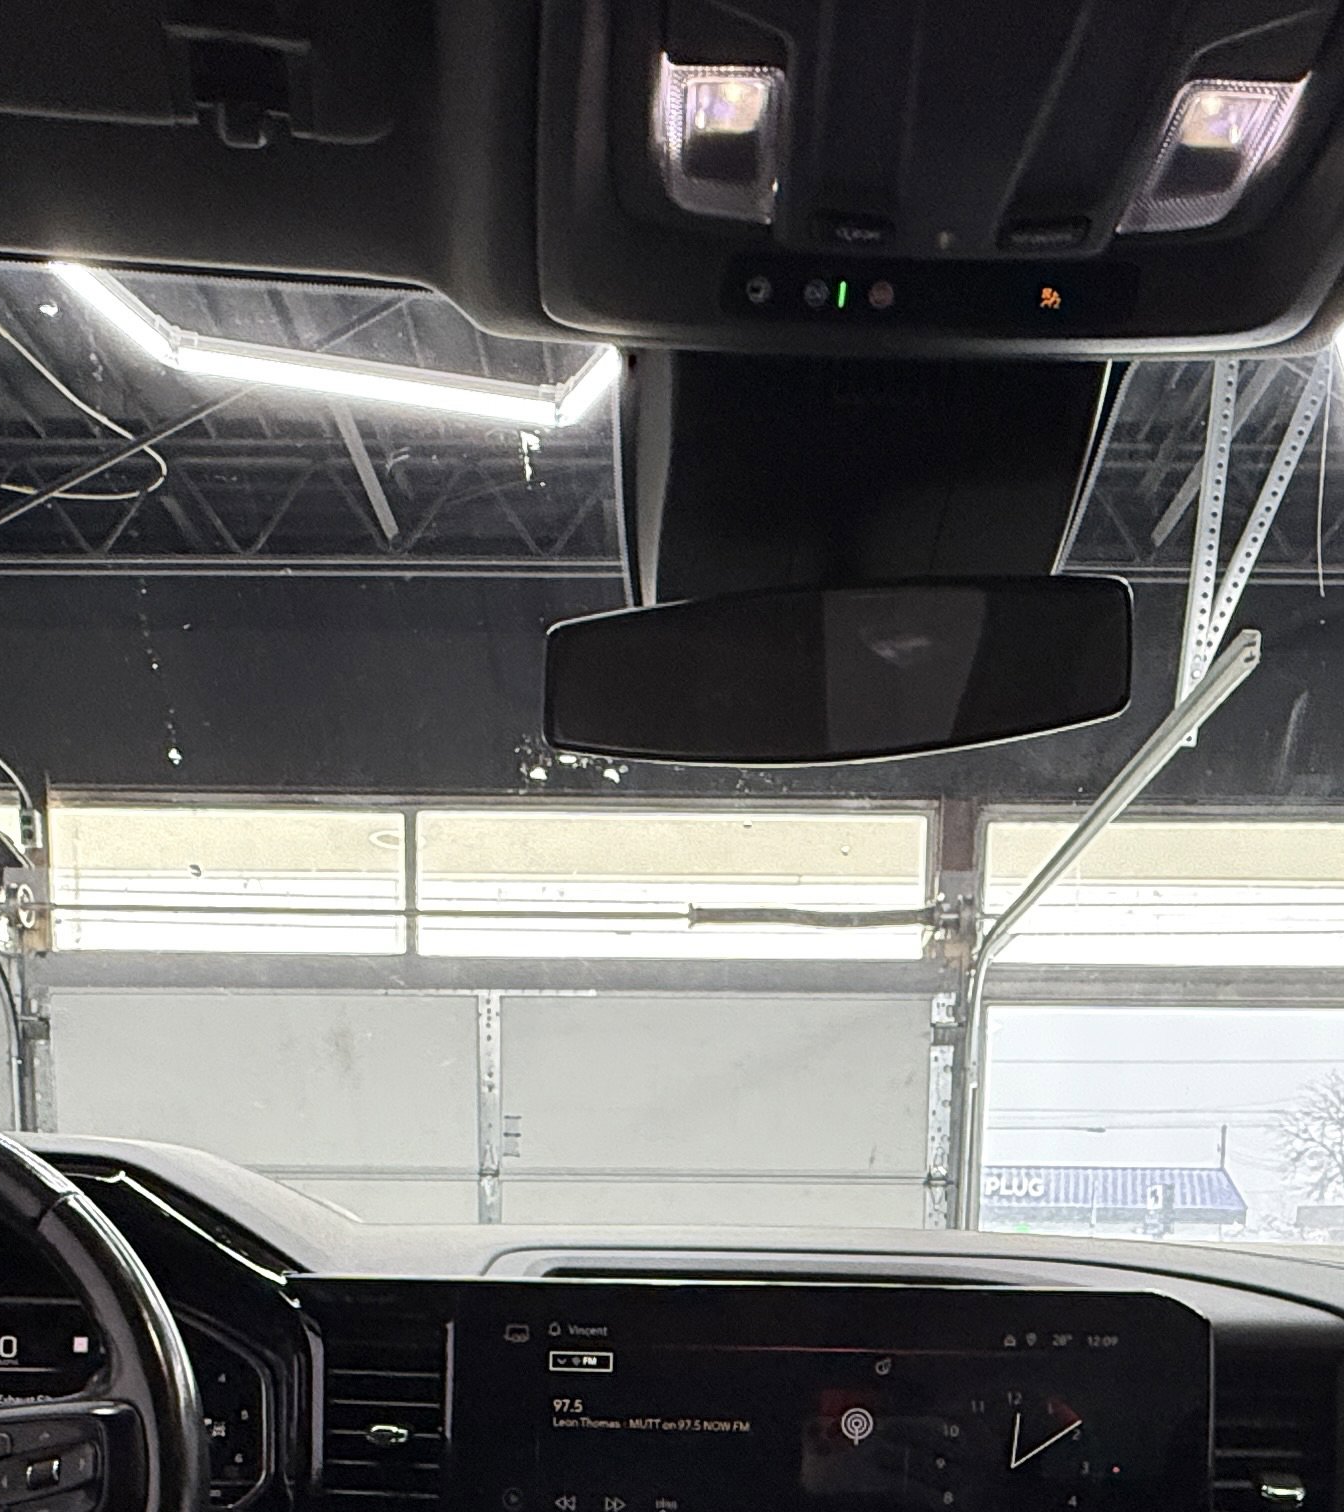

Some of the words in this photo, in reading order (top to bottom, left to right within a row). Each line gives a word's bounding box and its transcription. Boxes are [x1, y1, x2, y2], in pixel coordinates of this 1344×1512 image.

[984, 1175, 1045, 1197] PLUG
[568, 1323, 609, 1338] Vincent
[582, 1356, 598, 1366] FM
[552, 1399, 583, 1413] 97.5
[1008, 1391, 1023, 1406] 12
[552, 1416, 578, 1428] Leon
[580, 1417, 621, 1429] Thomas
[629, 1418, 661, 1430] MUTT
[662, 1421, 676, 1430] on
[677, 1419, 701, 1431] 97.5
[703, 1420, 731, 1431] NOW
[732, 1421, 750, 1432] FM
